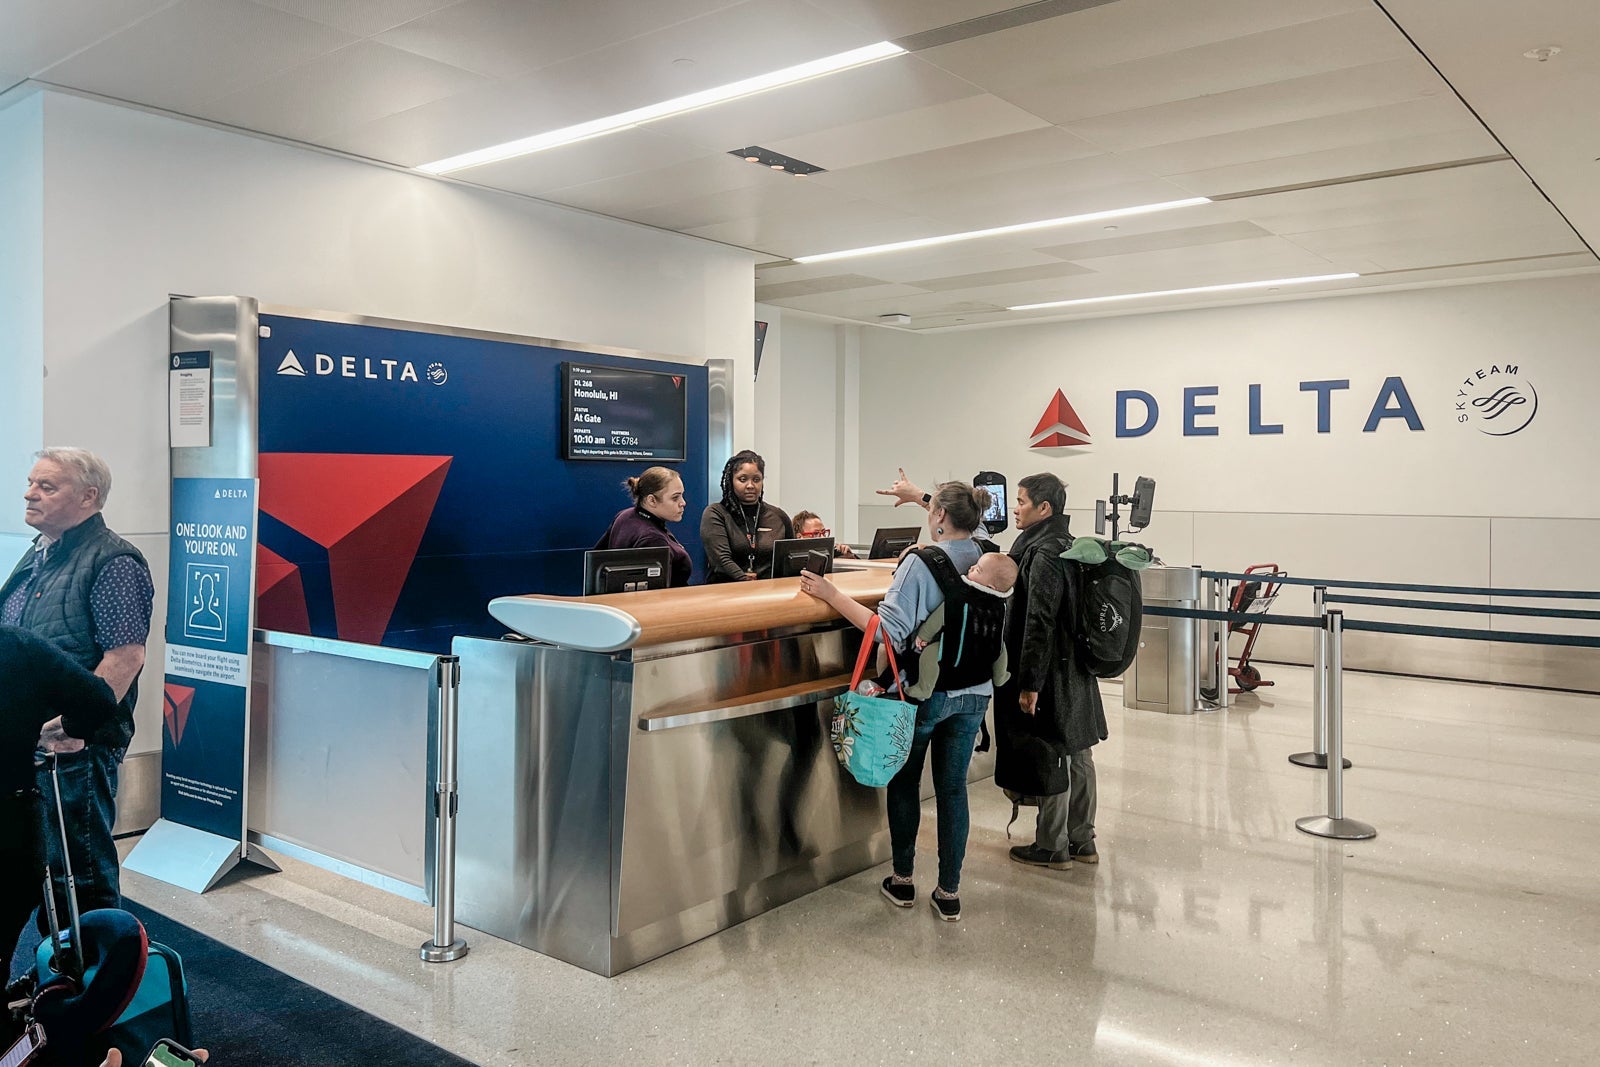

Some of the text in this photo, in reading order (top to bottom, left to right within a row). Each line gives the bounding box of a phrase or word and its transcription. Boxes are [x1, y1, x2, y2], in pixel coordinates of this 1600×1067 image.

[315, 354, 418, 382] DELTA
[574, 388, 618, 400] Honolulu, HI
[1456, 364, 1518, 422] SKYTEAM
[1115, 376, 1425, 438] DELTA
[574, 413, 601, 423] At Gate
[574, 435, 593, 444] 10:10
[611, 436, 638, 445] KE 6784
[222, 489, 248, 498] DELTA
[176, 523, 247, 539] ONE LOOK AND
[185, 540, 238, 556] YOU'RE ON.
[1100, 602, 1108, 632] OSPREY
